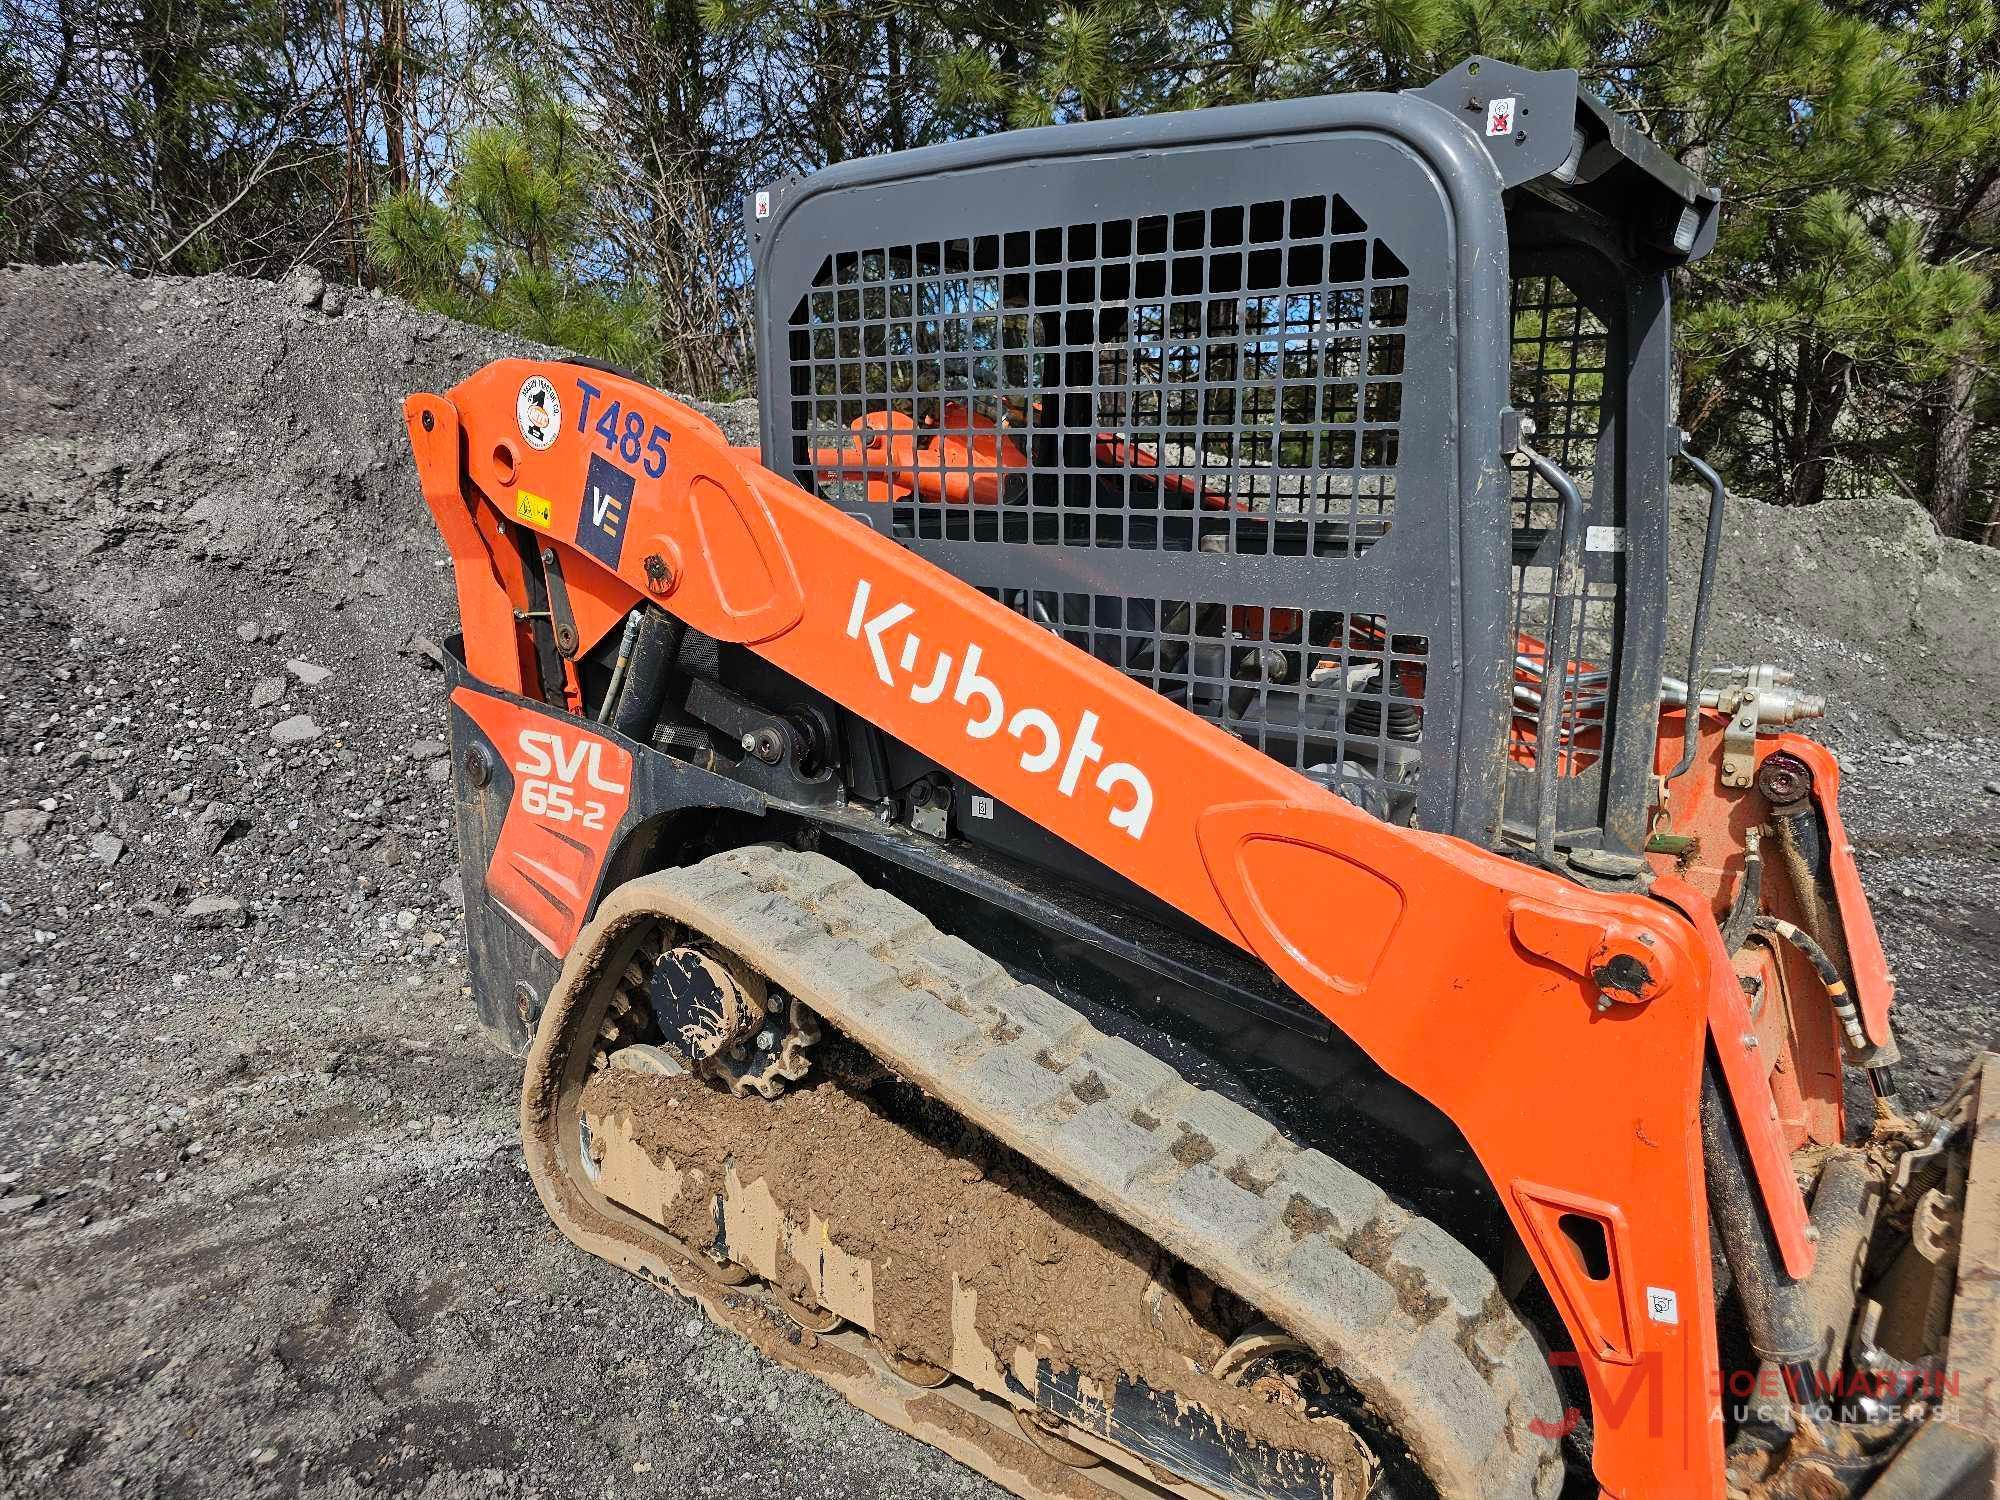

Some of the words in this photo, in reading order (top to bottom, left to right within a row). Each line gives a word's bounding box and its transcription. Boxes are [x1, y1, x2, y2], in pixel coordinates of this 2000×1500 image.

[576, 378, 671, 479] T485
[846, 578, 1154, 840] Kubota
[515, 729, 624, 794] SVL
[522, 779, 605, 831] 65-2
